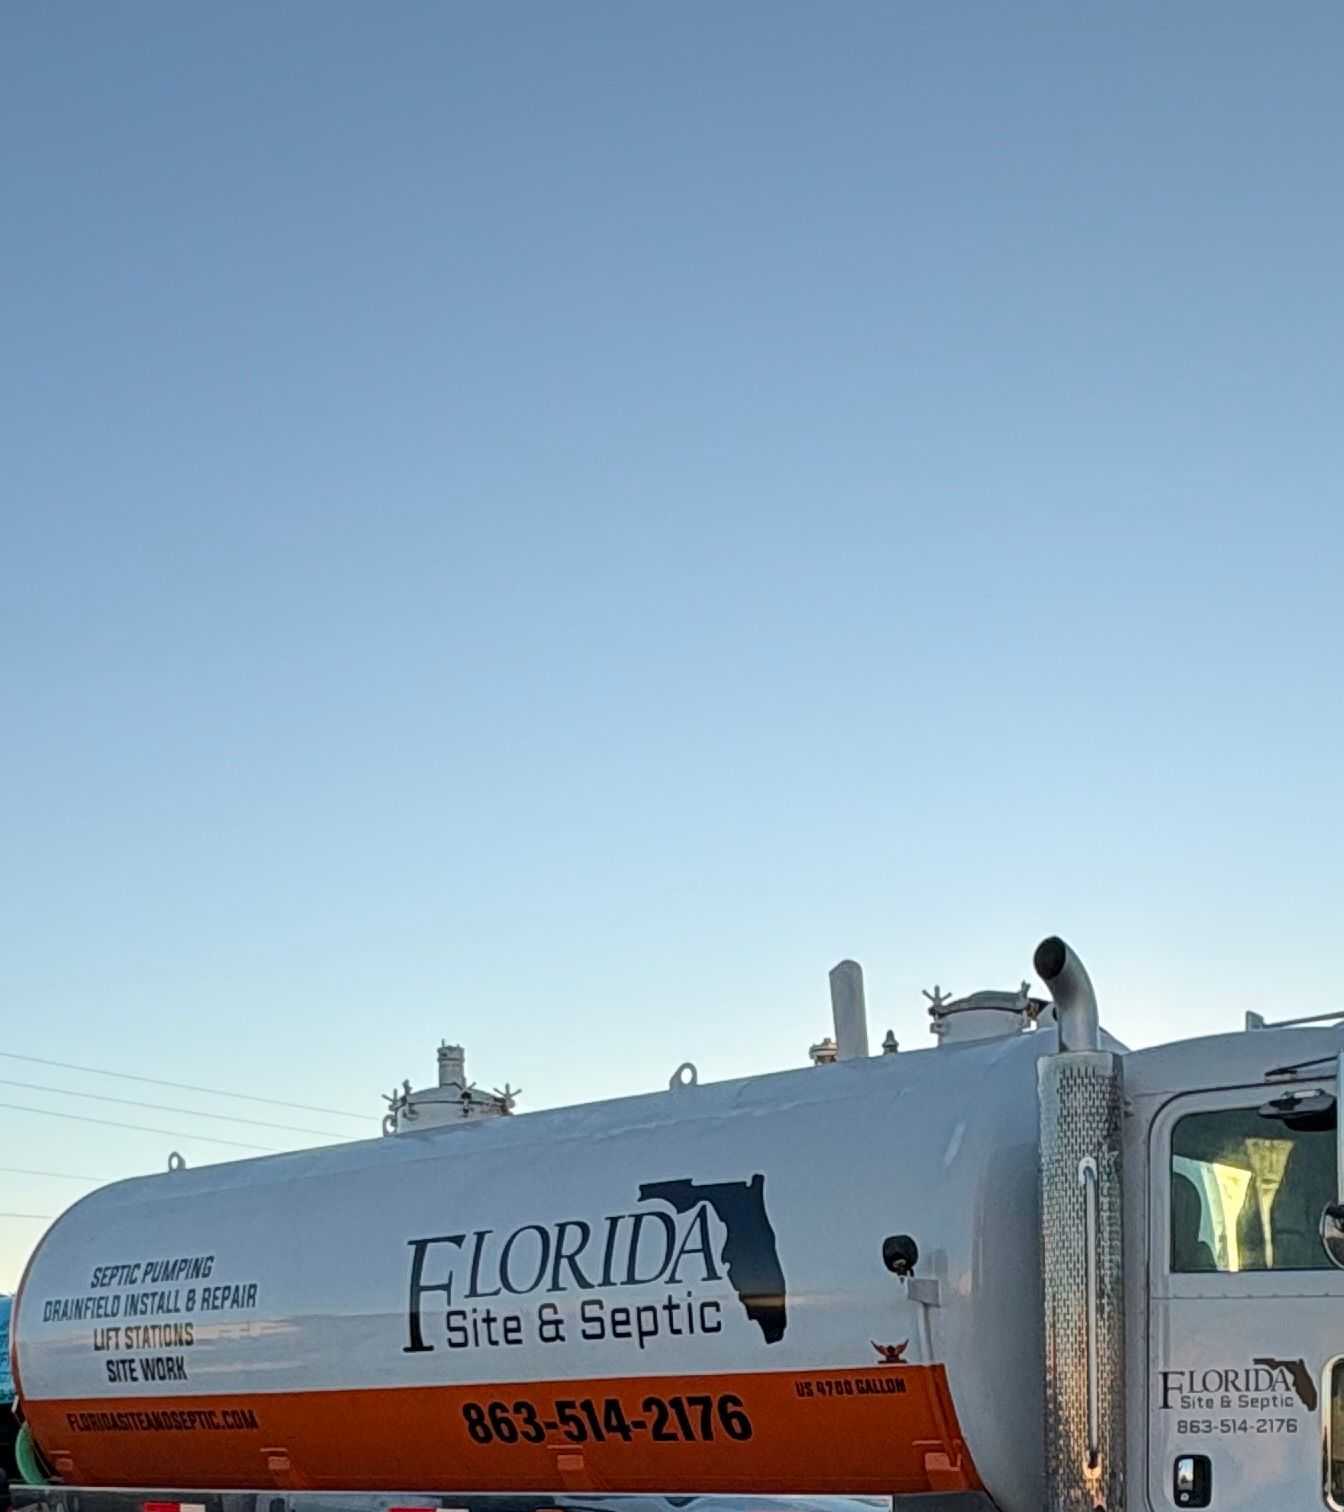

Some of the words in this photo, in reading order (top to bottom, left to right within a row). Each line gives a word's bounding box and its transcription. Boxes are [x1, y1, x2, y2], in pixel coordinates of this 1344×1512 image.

[90, 1263, 141, 1288] SEPTIC
[144, 1256, 215, 1284] PUMPING
[403, 1204, 723, 1352] FLORIDA
[43, 1295, 121, 1323] DRAINFIELD
[124, 1290, 181, 1317] INSTALL
[200, 1283, 258, 1311] REPAIR
[447, 1308, 523, 1348] Site
[538, 1303, 566, 1343] &
[581, 1291, 723, 1349] Septic
[93, 1326, 121, 1351] LIFT
[124, 1323, 194, 1349] STATIONS
[106, 1359, 139, 1383] SITE
[139, 1356, 188, 1382] WORK
[795, 1381, 814, 1398] US
[856, 1378, 907, 1394] GALLON
[1158, 1368, 1292, 1410] FLORIDA
[1180, 1395, 1214, 1410] Site
[1221, 1395, 1232, 1409] &
[1238, 1393, 1295, 1411] Septic
[65, 1410, 259, 1433] FLORIDASITEANDSEPTIC.COM
[463, 1395, 752, 1444] 863-514-2176
[1177, 1419, 1298, 1434] 863-514-2176
